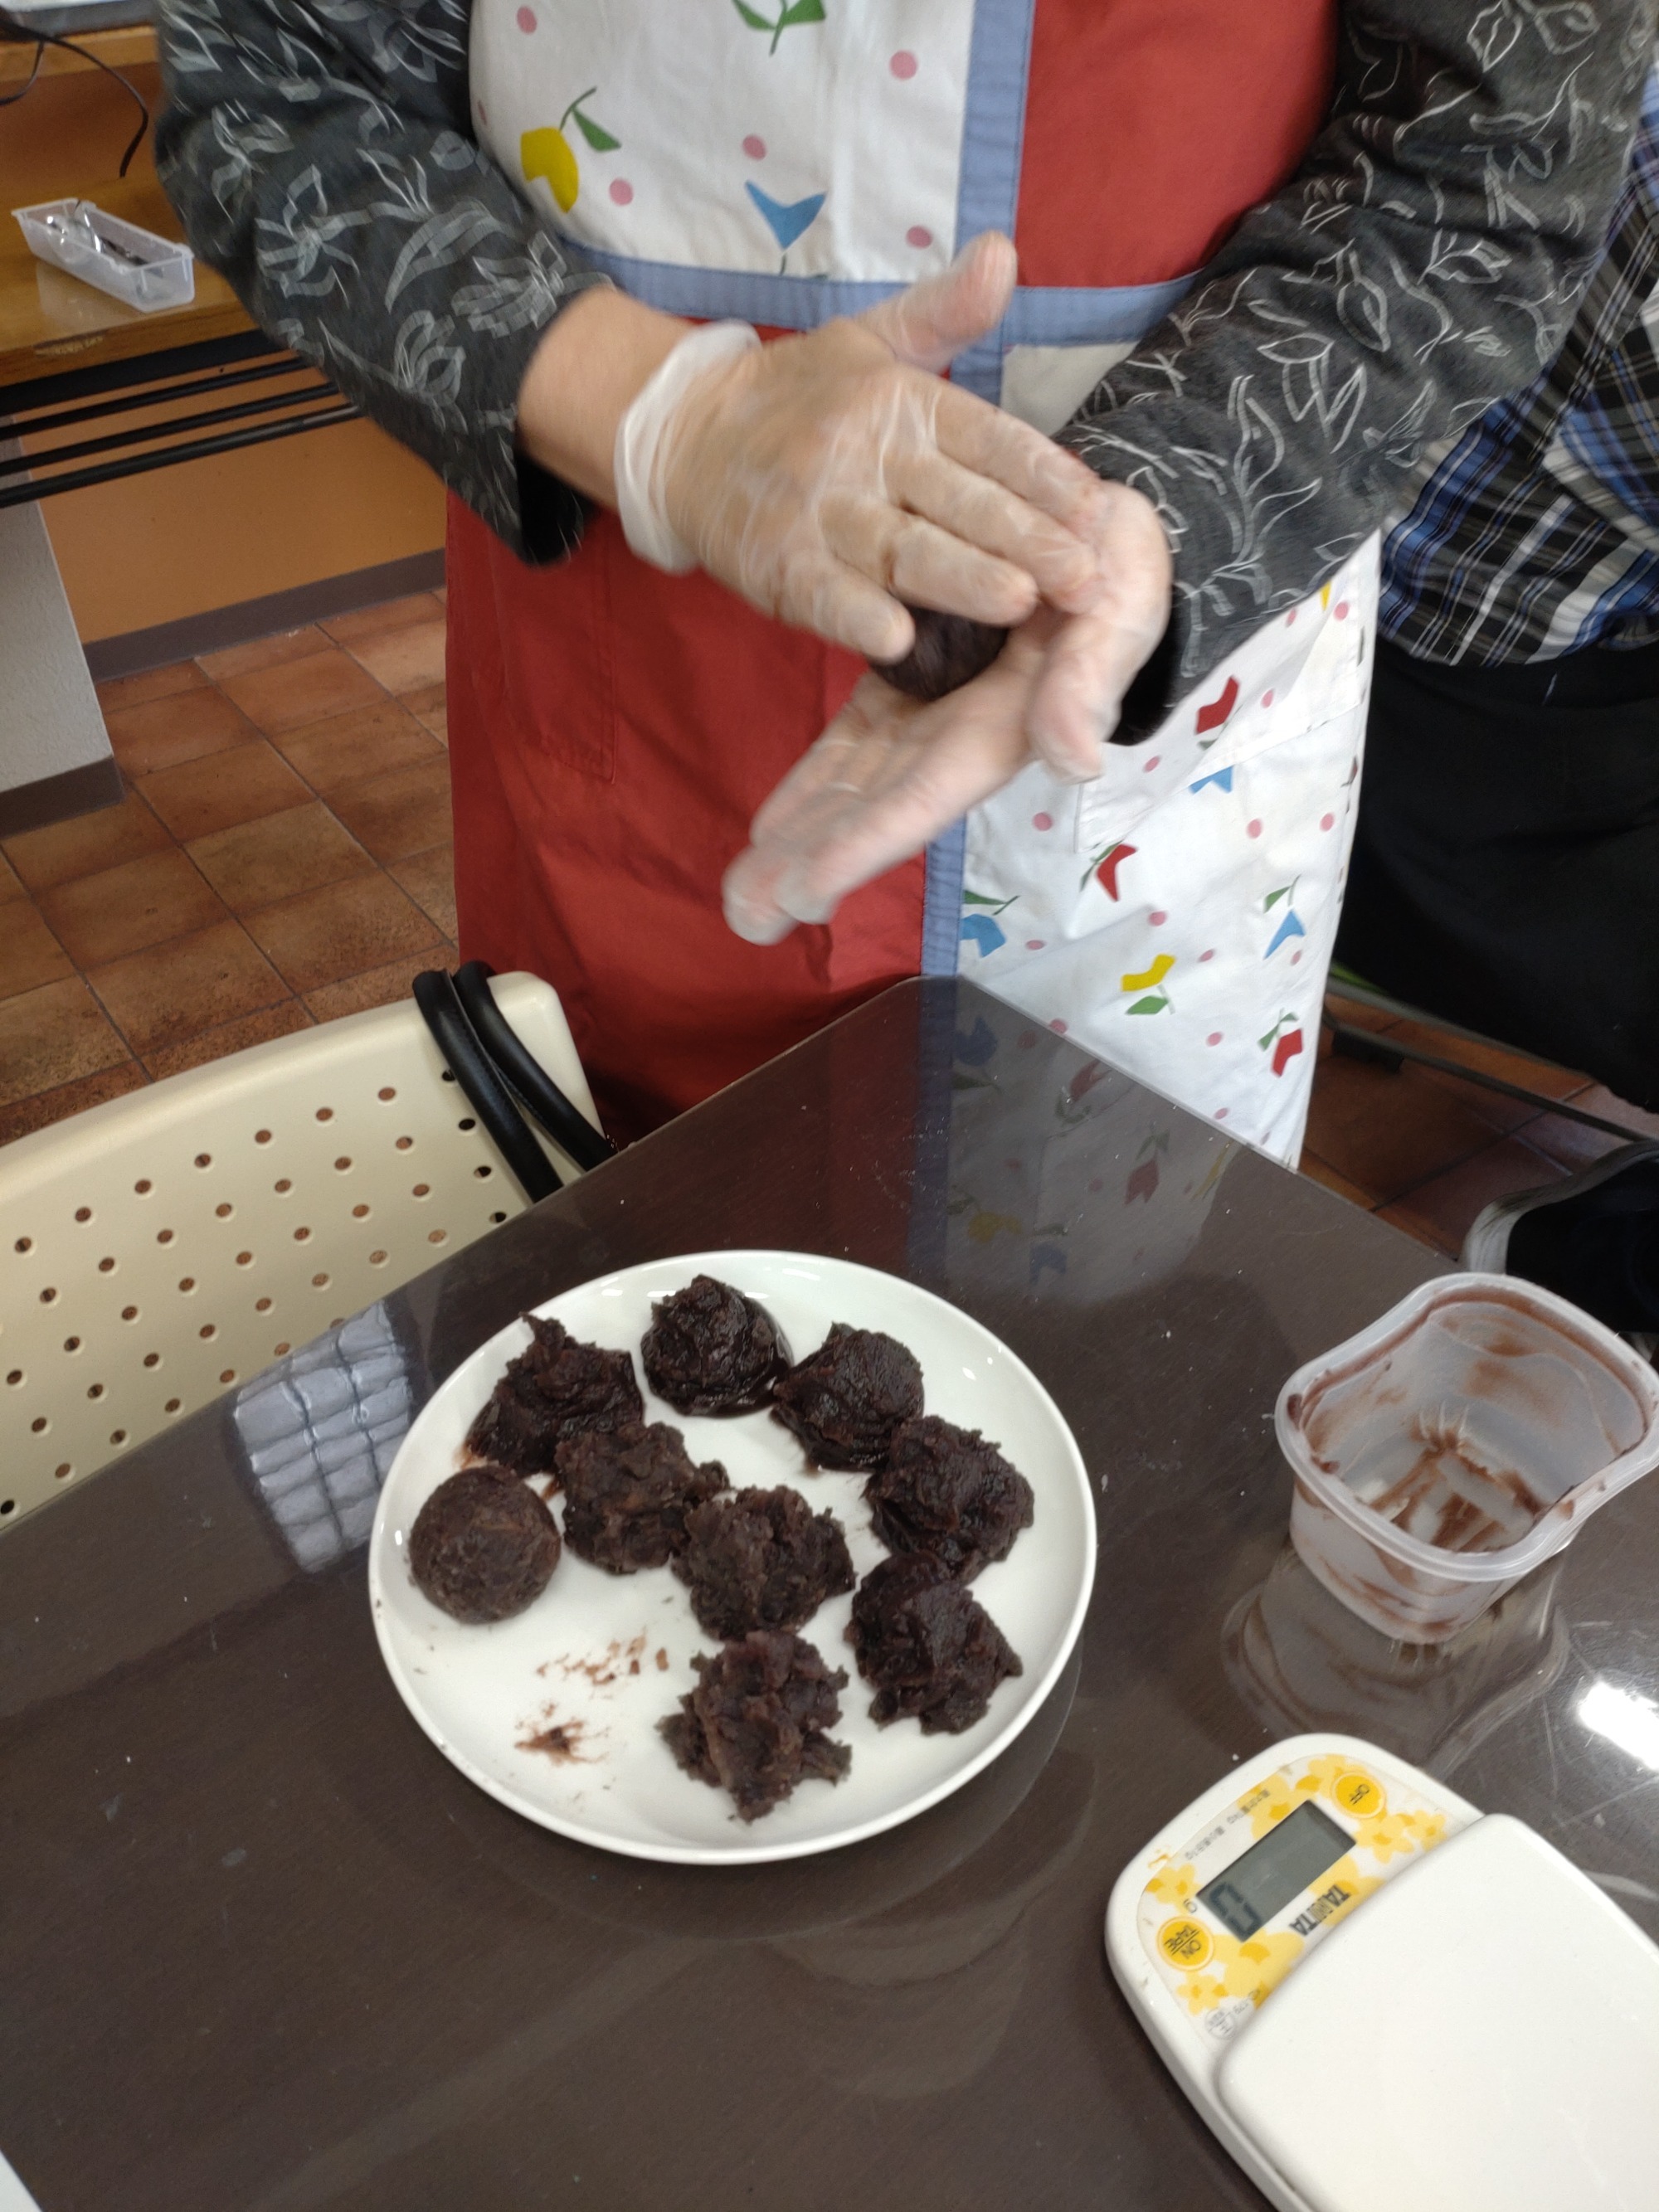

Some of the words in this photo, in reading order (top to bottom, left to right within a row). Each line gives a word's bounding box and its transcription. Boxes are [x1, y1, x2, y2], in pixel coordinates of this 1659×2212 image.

[1349, 1784, 1370, 1806] OFF
[1289, 1884, 1351, 1937] TANITA
[1180, 1939, 1202, 1960] ON
